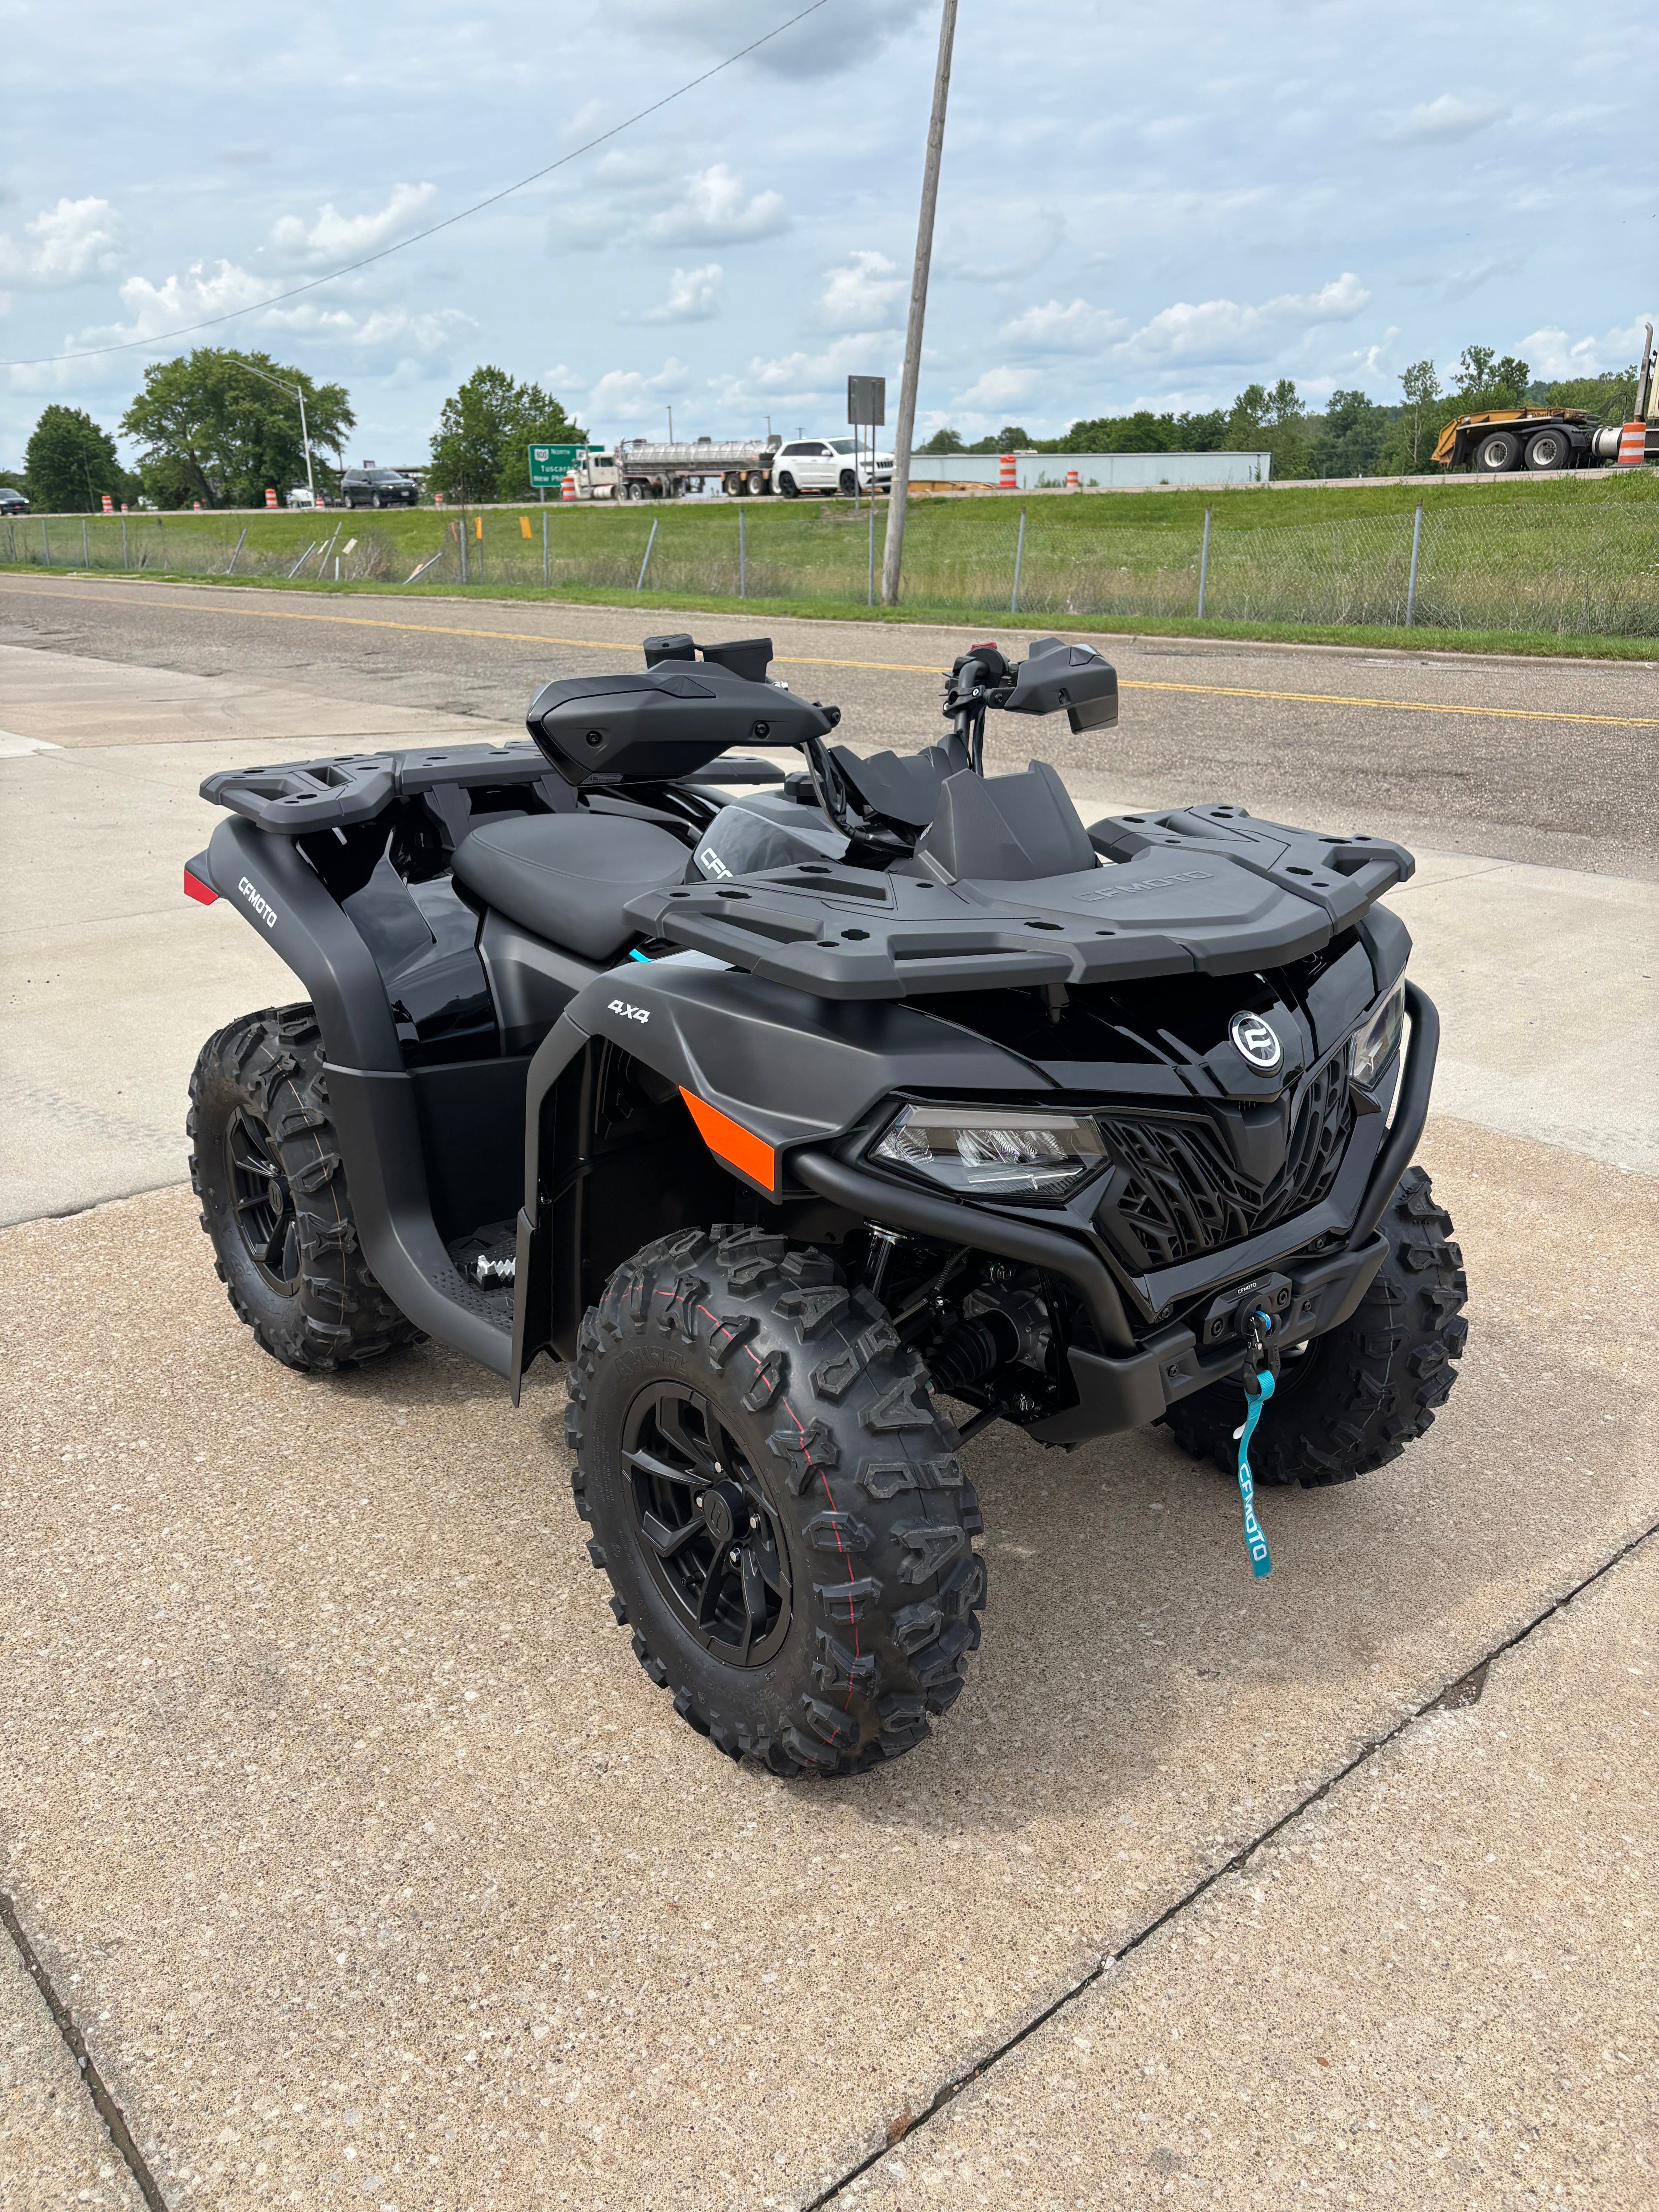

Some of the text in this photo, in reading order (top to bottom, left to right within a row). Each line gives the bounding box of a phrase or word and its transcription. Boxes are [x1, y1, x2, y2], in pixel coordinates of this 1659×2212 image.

[238, 876, 278, 928] CFMOTO
[1072, 871, 1214, 902] CFMOTO
[1237, 1282, 1257, 1294] CFMOTO
[614, 1345, 688, 1381] ABUZZ
[1238, 1462, 1268, 1562] CFMOTO
